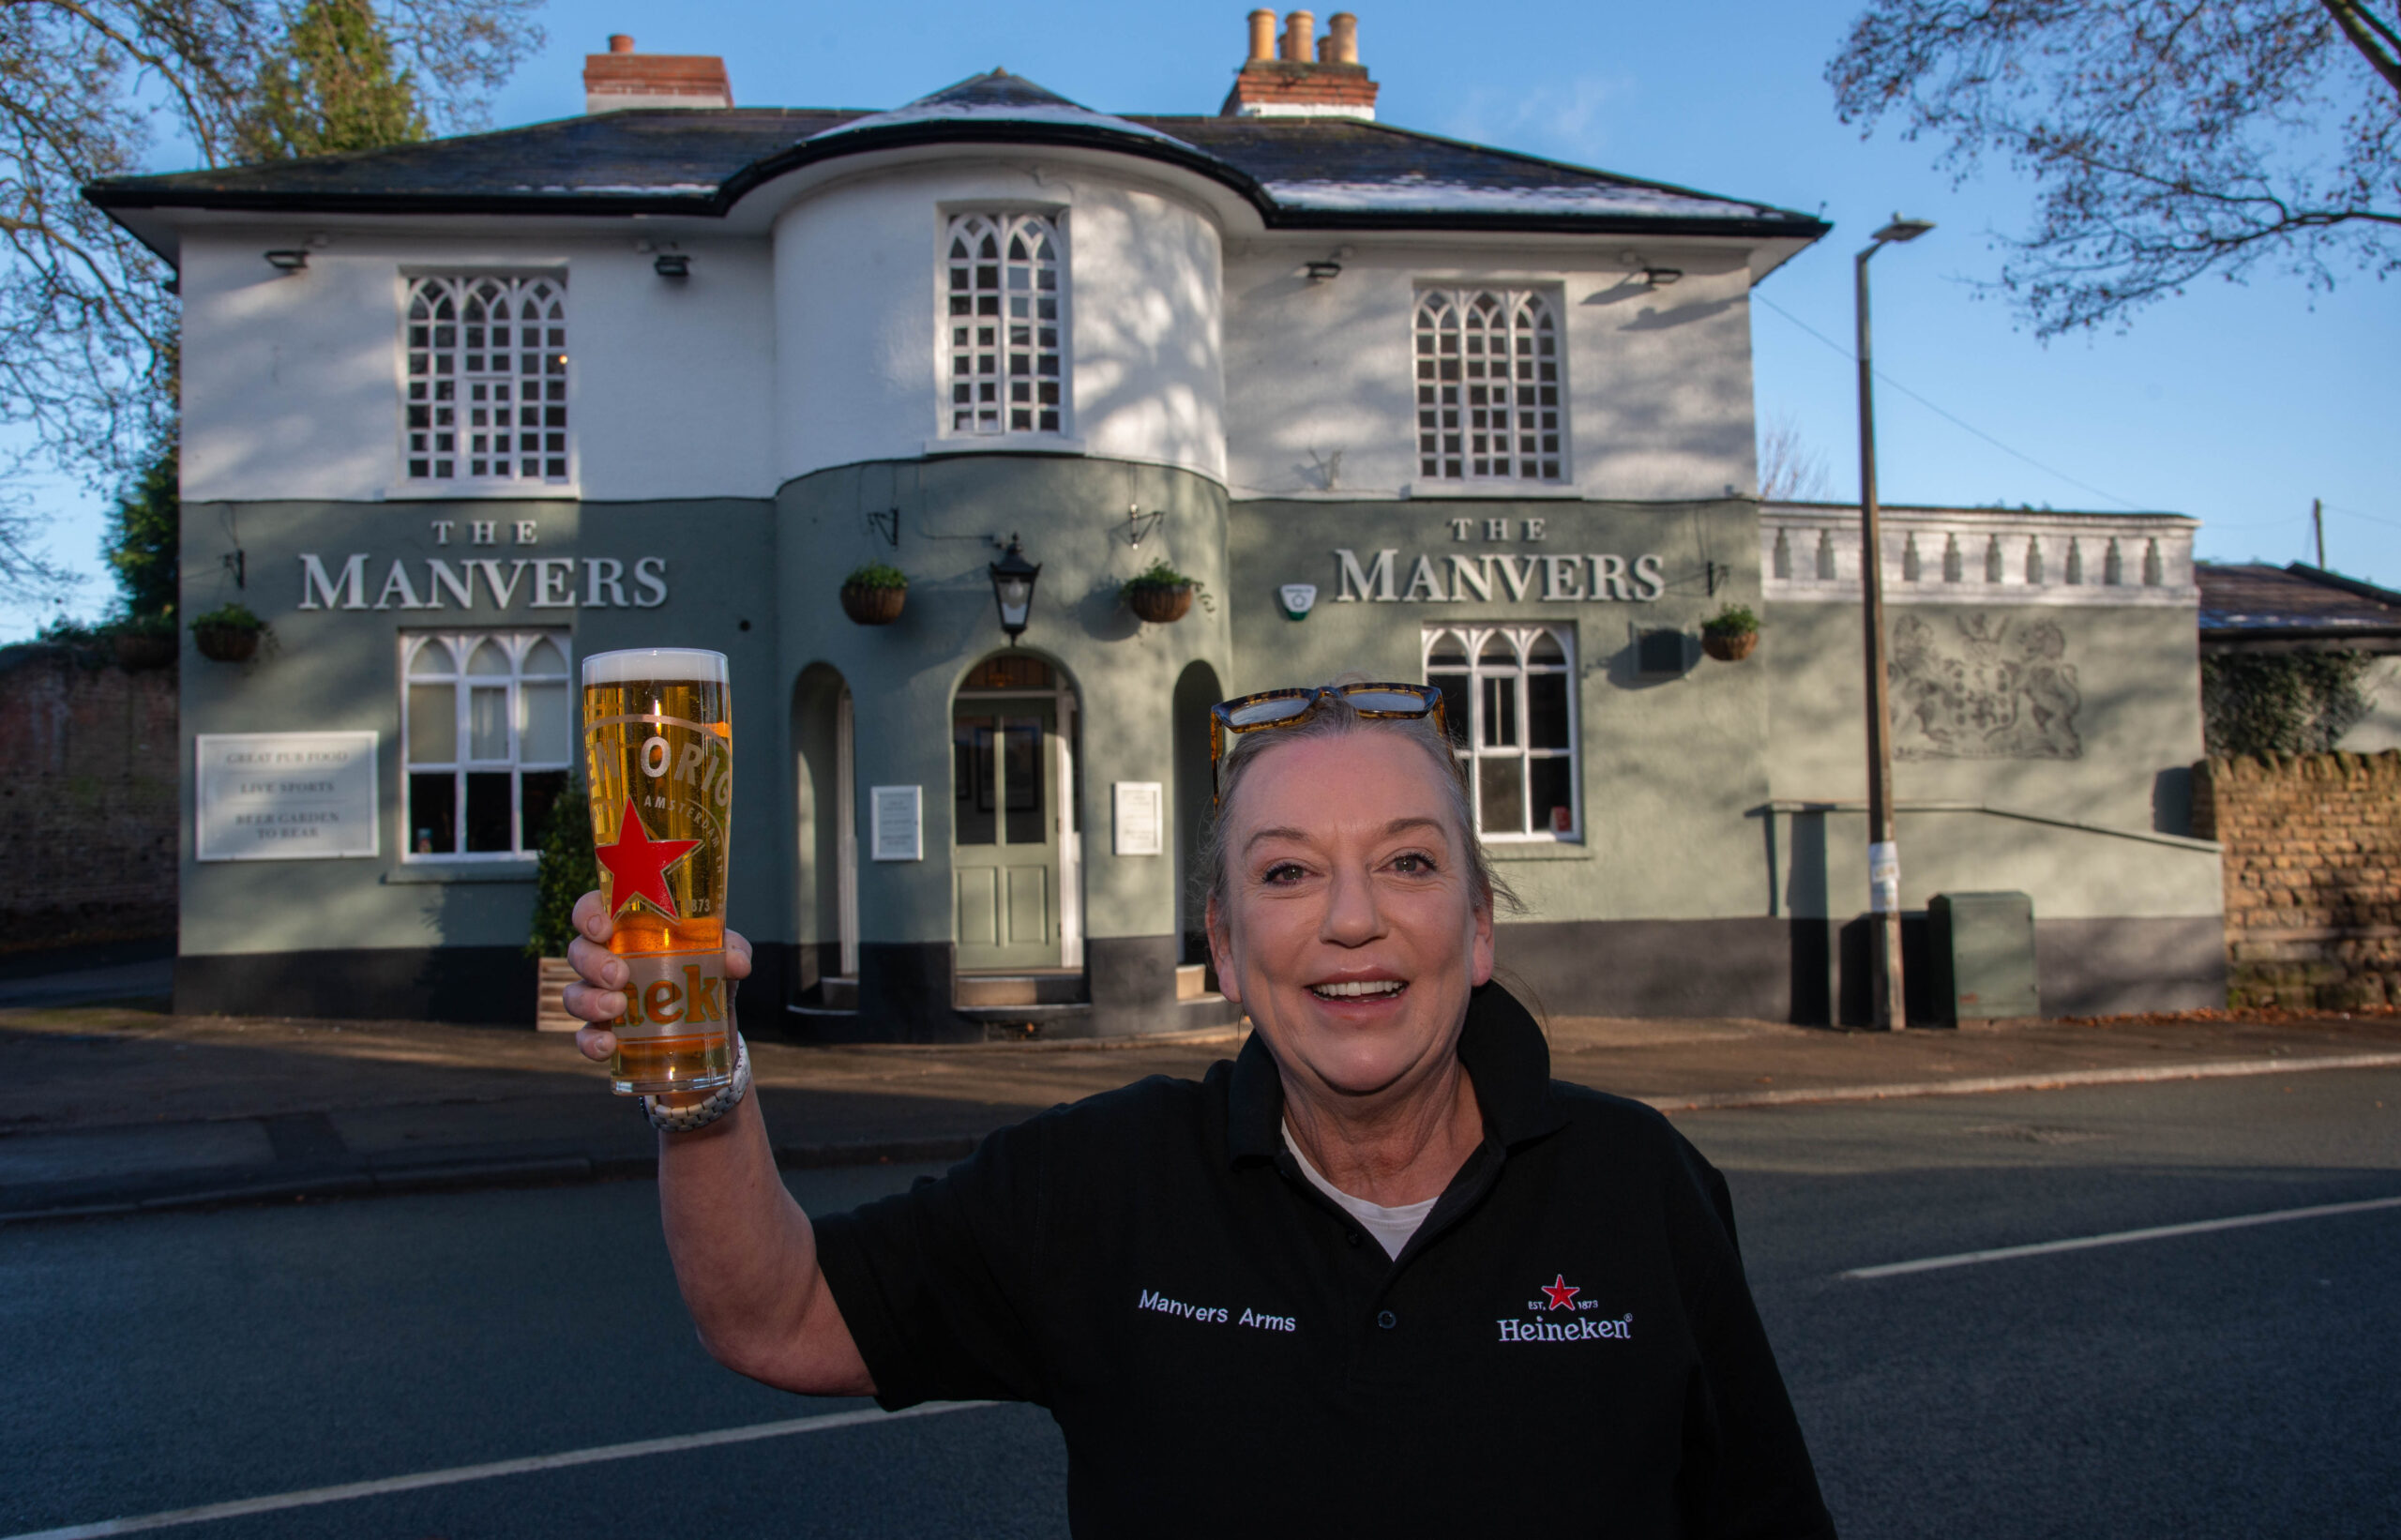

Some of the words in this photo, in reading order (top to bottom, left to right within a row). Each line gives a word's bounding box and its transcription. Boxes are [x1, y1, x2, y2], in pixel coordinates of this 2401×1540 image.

[430, 520, 538, 545] THE
[1451, 518, 1548, 541] THE
[297, 552, 669, 610] MANVERS
[1335, 548, 1666, 602] MANVERS
[226, 752, 272, 765] GREAT
[276, 751, 305, 764] PUB
[308, 751, 348, 763] FOOD
[240, 782, 274, 794] LIVE
[279, 780, 336, 793] SPORTS
[235, 812, 276, 826] BEER
[278, 809, 340, 824] GARDEN
[643, 794, 721, 849] AMSTERDAM
[257, 828, 278, 839] TO
[281, 826, 319, 838] REAR
[686, 898, 710, 913] 1873
[1138, 1289, 1229, 1323] Manvers
[1238, 1306, 1296, 1333] Arms
[1577, 1299, 1598, 1310] 1873
